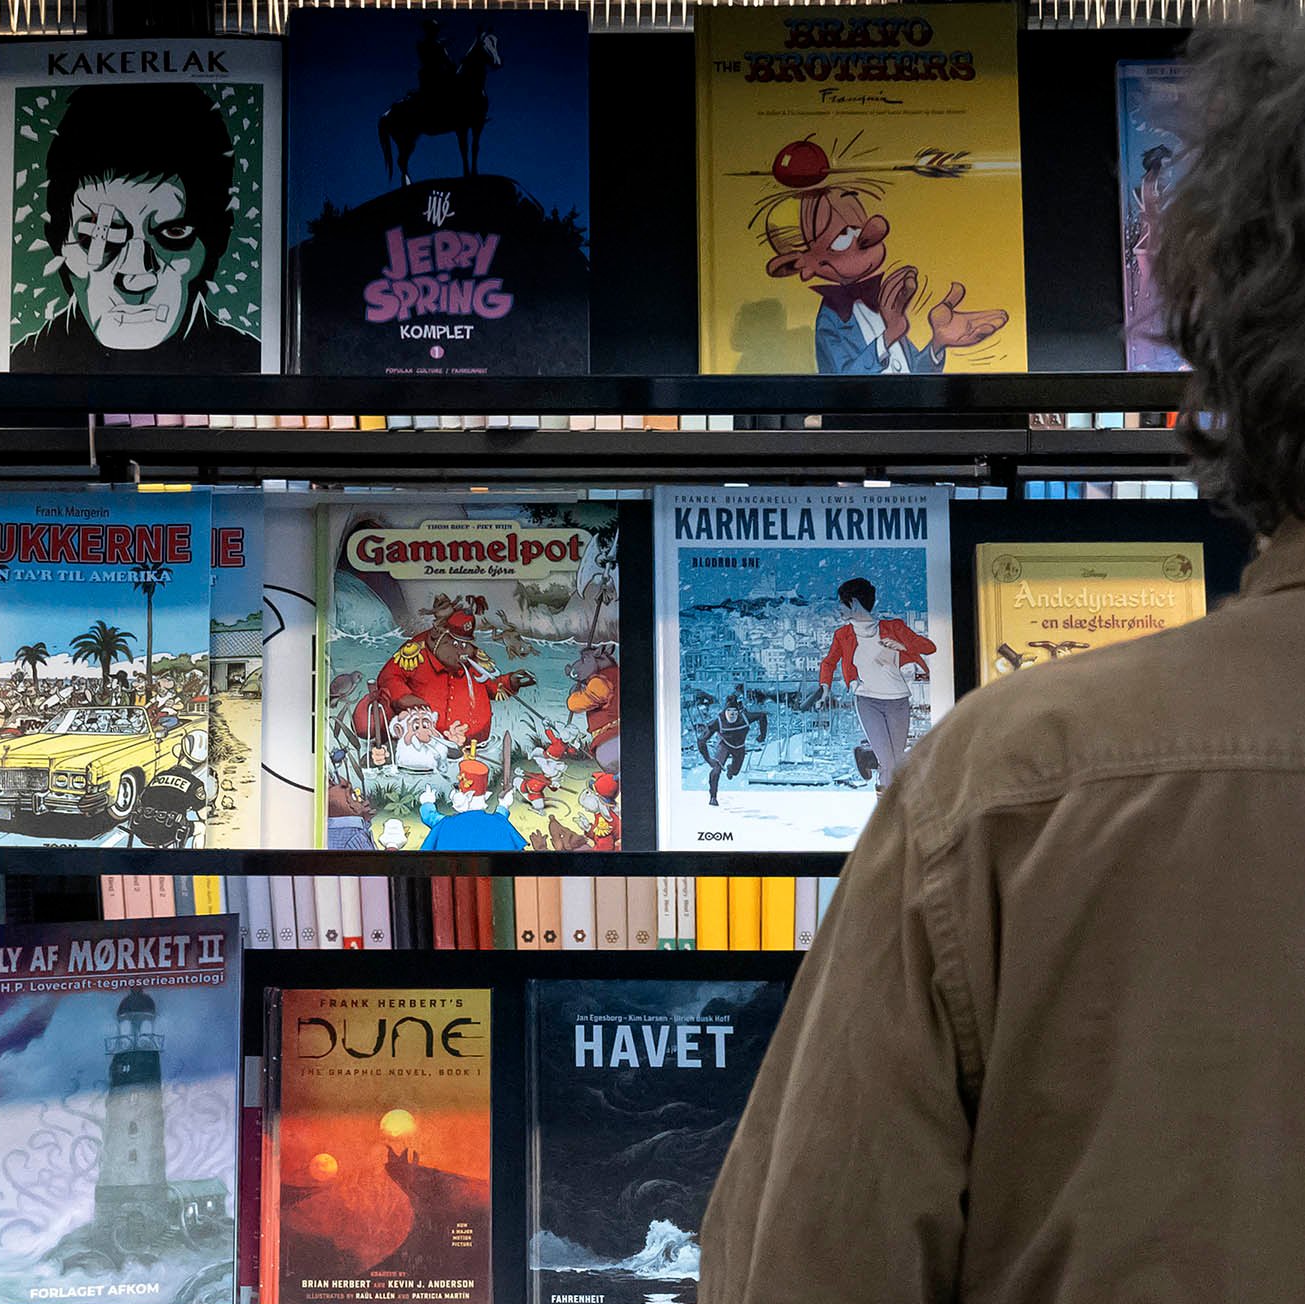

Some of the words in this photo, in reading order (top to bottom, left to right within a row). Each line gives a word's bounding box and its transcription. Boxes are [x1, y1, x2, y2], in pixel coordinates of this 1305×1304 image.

[784, 17, 934, 49] BRAVO
[48, 50, 228, 76] KAKERLAK
[713, 61, 741, 73] THE
[743, 51, 977, 82] BROTHERS
[381, 226, 501, 281] JERRY
[399, 324, 474, 340] KOMPLET
[36, 506, 63, 518] Frank
[66, 507, 110, 520] Margerin
[674, 507, 815, 541] KARMELA
[824, 507, 929, 541] KRIMM
[356, 532, 585, 566] Gammelpot
[13, 569, 53, 582] TA'R
[57, 570, 85, 583] TIL
[88, 570, 173, 583] AMERIKA
[423, 564, 445, 576] Den
[448, 564, 486, 577] talende
[487, 565, 517, 579] bjørn
[1013, 580, 1178, 613] Andedynastiet
[1041, 619, 1059, 630] en
[1062, 612, 1167, 633] slægtskrønike
[152, 776, 190, 795] POLICE
[30, 945, 59, 972] AF
[67, 936, 190, 973] MØRKET
[198, 934, 224, 964] II
[1, 981, 26, 993] H.P.
[29, 972, 224, 993] Lovecraft-tegneserieantologi
[319, 999, 369, 1008] FRANK
[377, 999, 464, 1008] HERBERT'S
[297, 1016, 485, 1059] DUNE
[574, 1025, 735, 1069] HAVET
[30, 1286, 105, 1299] FORLAGET
[107, 1282, 160, 1296] AFKOM
[301, 1279, 329, 1289] BRIAN
[331, 1279, 372, 1289] HERBERT
[388, 1280, 415, 1289] KEVIN
[416, 1280, 425, 1289] J.
[427, 1279, 475, 1289] ANDERSON
[551, 1295, 605, 1304] FAHRENHEIT
